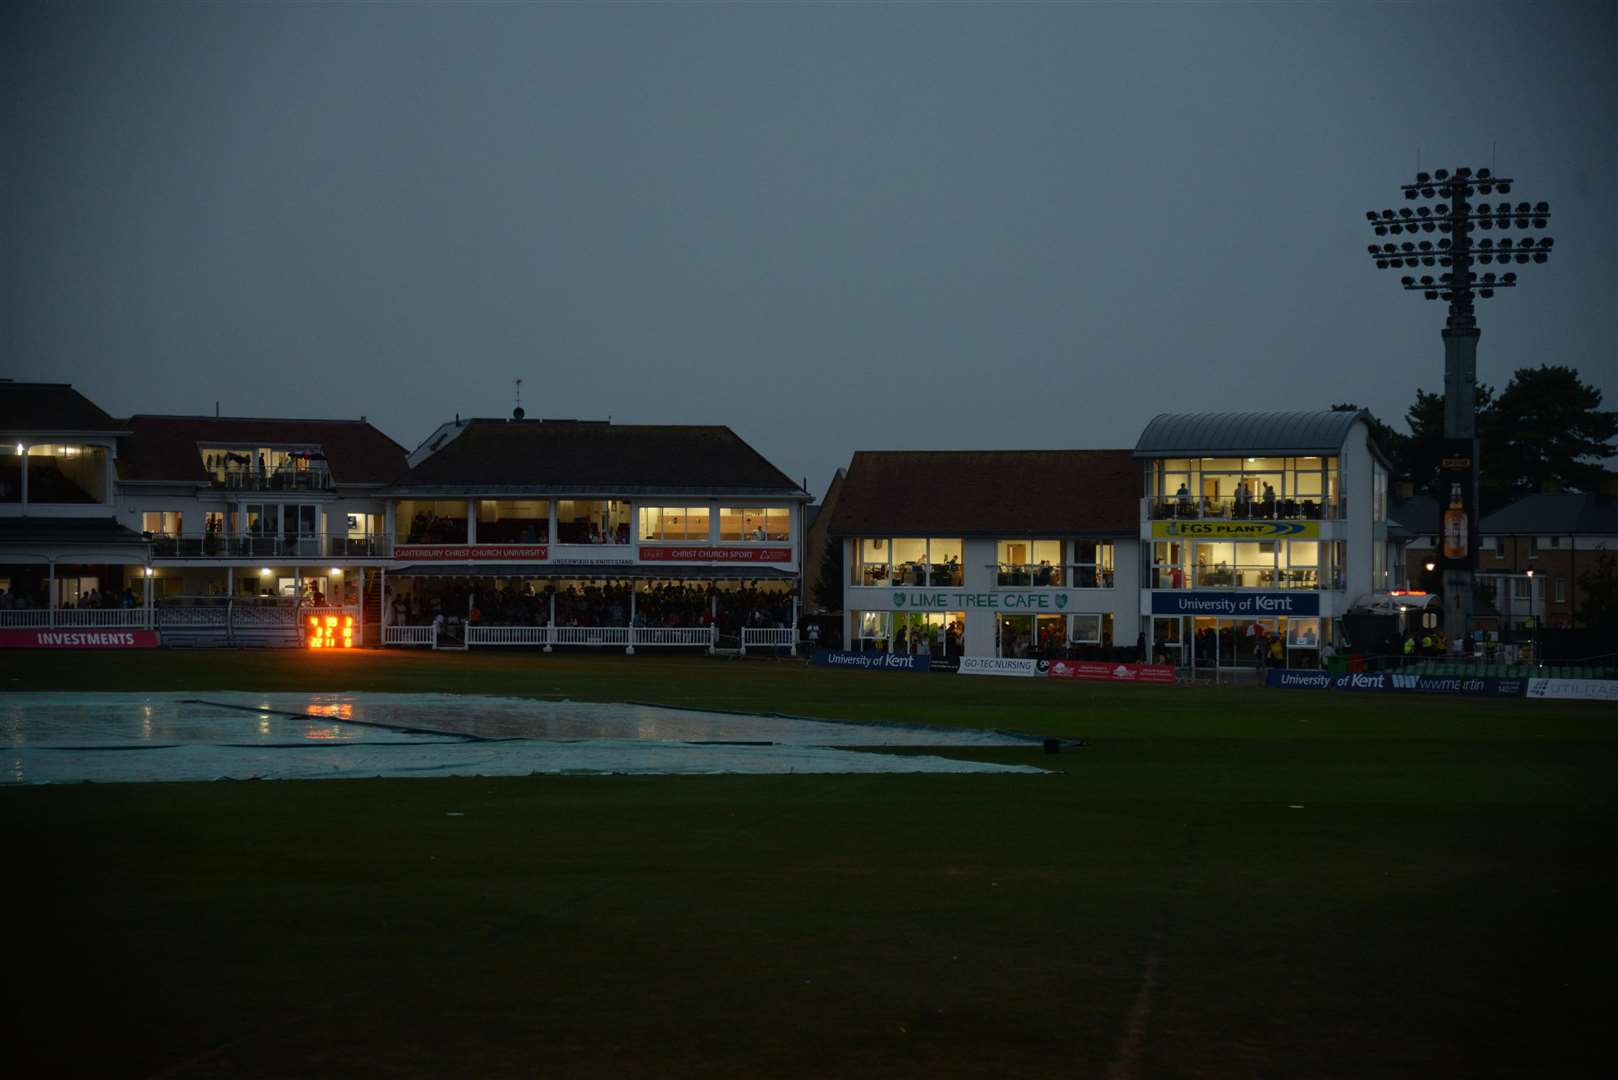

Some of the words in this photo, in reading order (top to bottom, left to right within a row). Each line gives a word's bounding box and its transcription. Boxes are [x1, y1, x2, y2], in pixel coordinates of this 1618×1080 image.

[1181, 524, 1212, 533] FGS
[1216, 525, 1265, 533] PLANT
[445, 549, 470, 558] CHRIST
[471, 550, 504, 558] CHURCH
[672, 550, 697, 558] CHRIST
[698, 550, 729, 558] CHURCH
[730, 550, 753, 559] SPORT
[910, 594, 948, 607] LIME
[953, 594, 999, 607] TREE
[1003, 594, 1049, 608] CAFE
[1178, 598, 1236, 613] University
[1239, 598, 1253, 610] of
[1255, 595, 1295, 611] Kent
[37, 632, 135, 645] INVESTMENTS
[828, 653, 871, 668] University
[873, 654, 883, 666] of
[884, 654, 915, 668] Kent
[964, 658, 993, 669] GO-TEC
[995, 659, 1032, 671] NURSING
[1280, 673, 1331, 689] University
[1337, 674, 1351, 687] of
[1352, 673, 1385, 688] Kent
